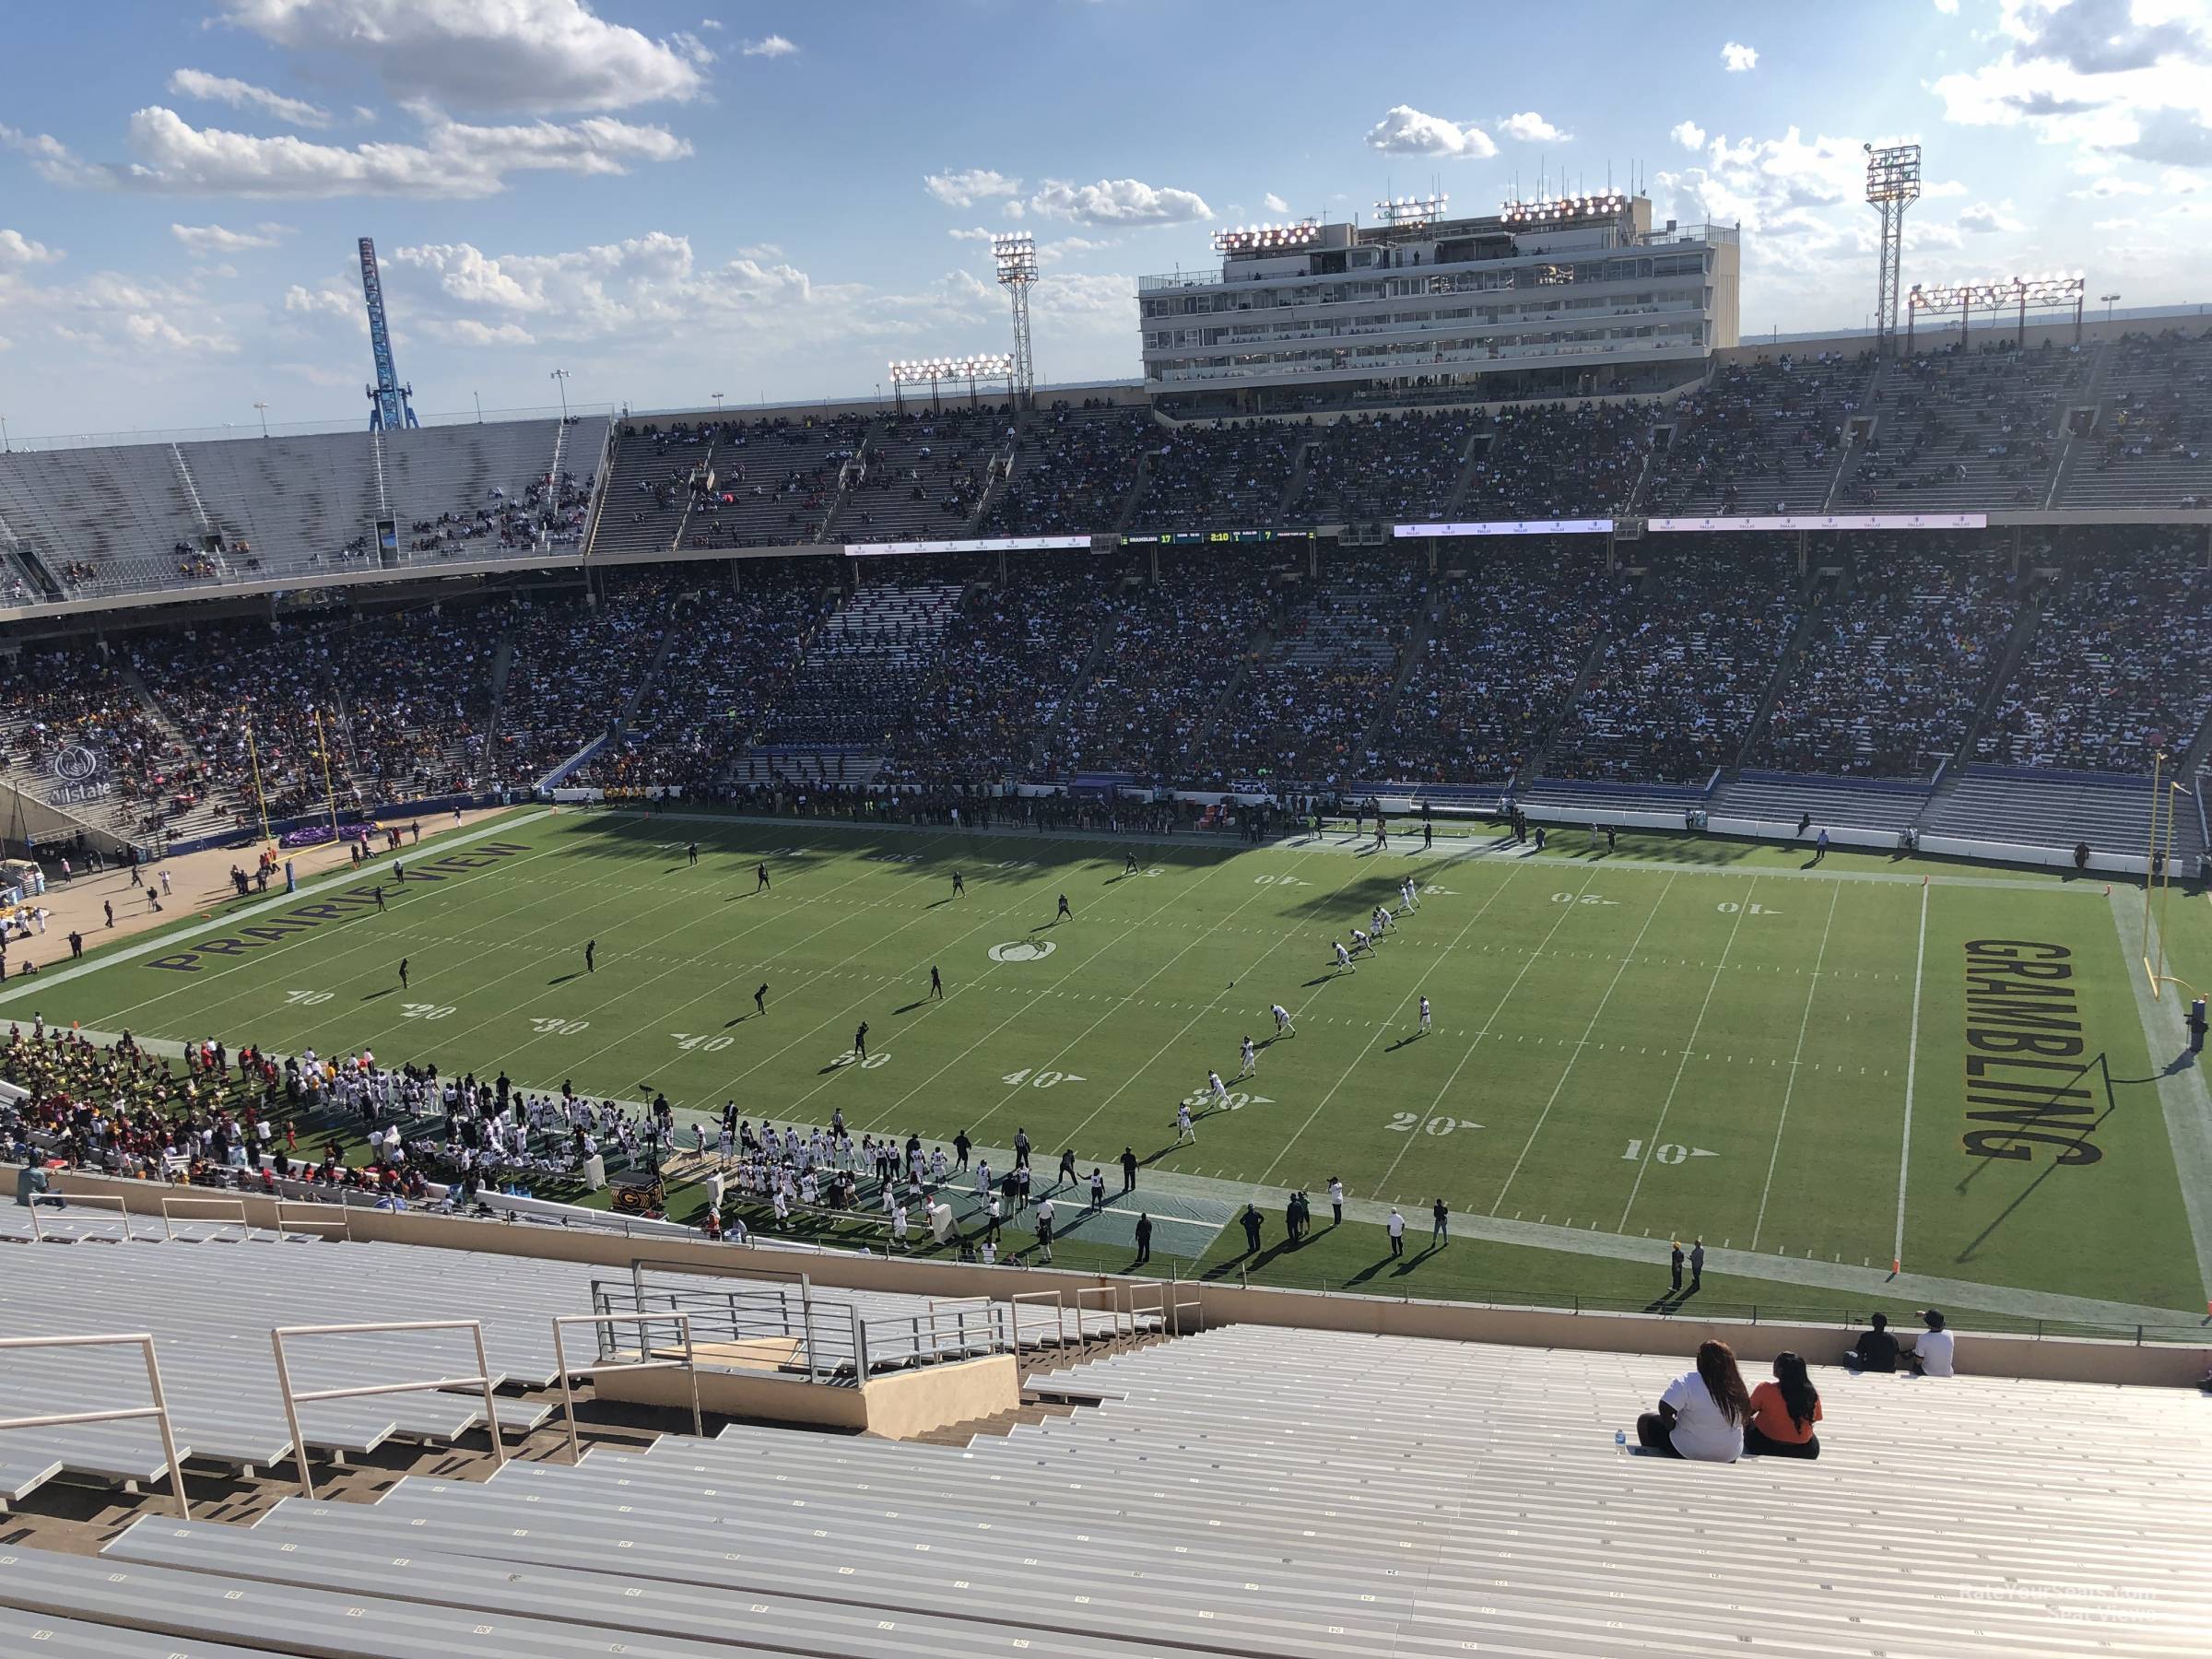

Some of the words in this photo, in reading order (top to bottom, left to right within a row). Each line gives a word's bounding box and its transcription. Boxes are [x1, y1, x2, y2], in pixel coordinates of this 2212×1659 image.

[1161, 535, 1171, 543] 17
[1210, 533, 1229, 542] 2:10
[1265, 531, 1271, 540] 7
[143, 886, 414, 973] PRAIRIE
[384, 841, 535, 881] VIEW
[1717, 902, 1763, 914] 10
[284, 990, 335, 1006] 10
[533, 1018, 591, 1036] 30
[677, 1034, 735, 1053] 40
[1962, 939, 2103, 1166] GRAMBLING
[830, 1049, 892, 1069] 50
[1001, 1067, 1065, 1088] 40
[1182, 1088, 1251, 1111] 30
[1383, 1112, 1457, 1136] 20
[1619, 1139, 1688, 1165] 10
